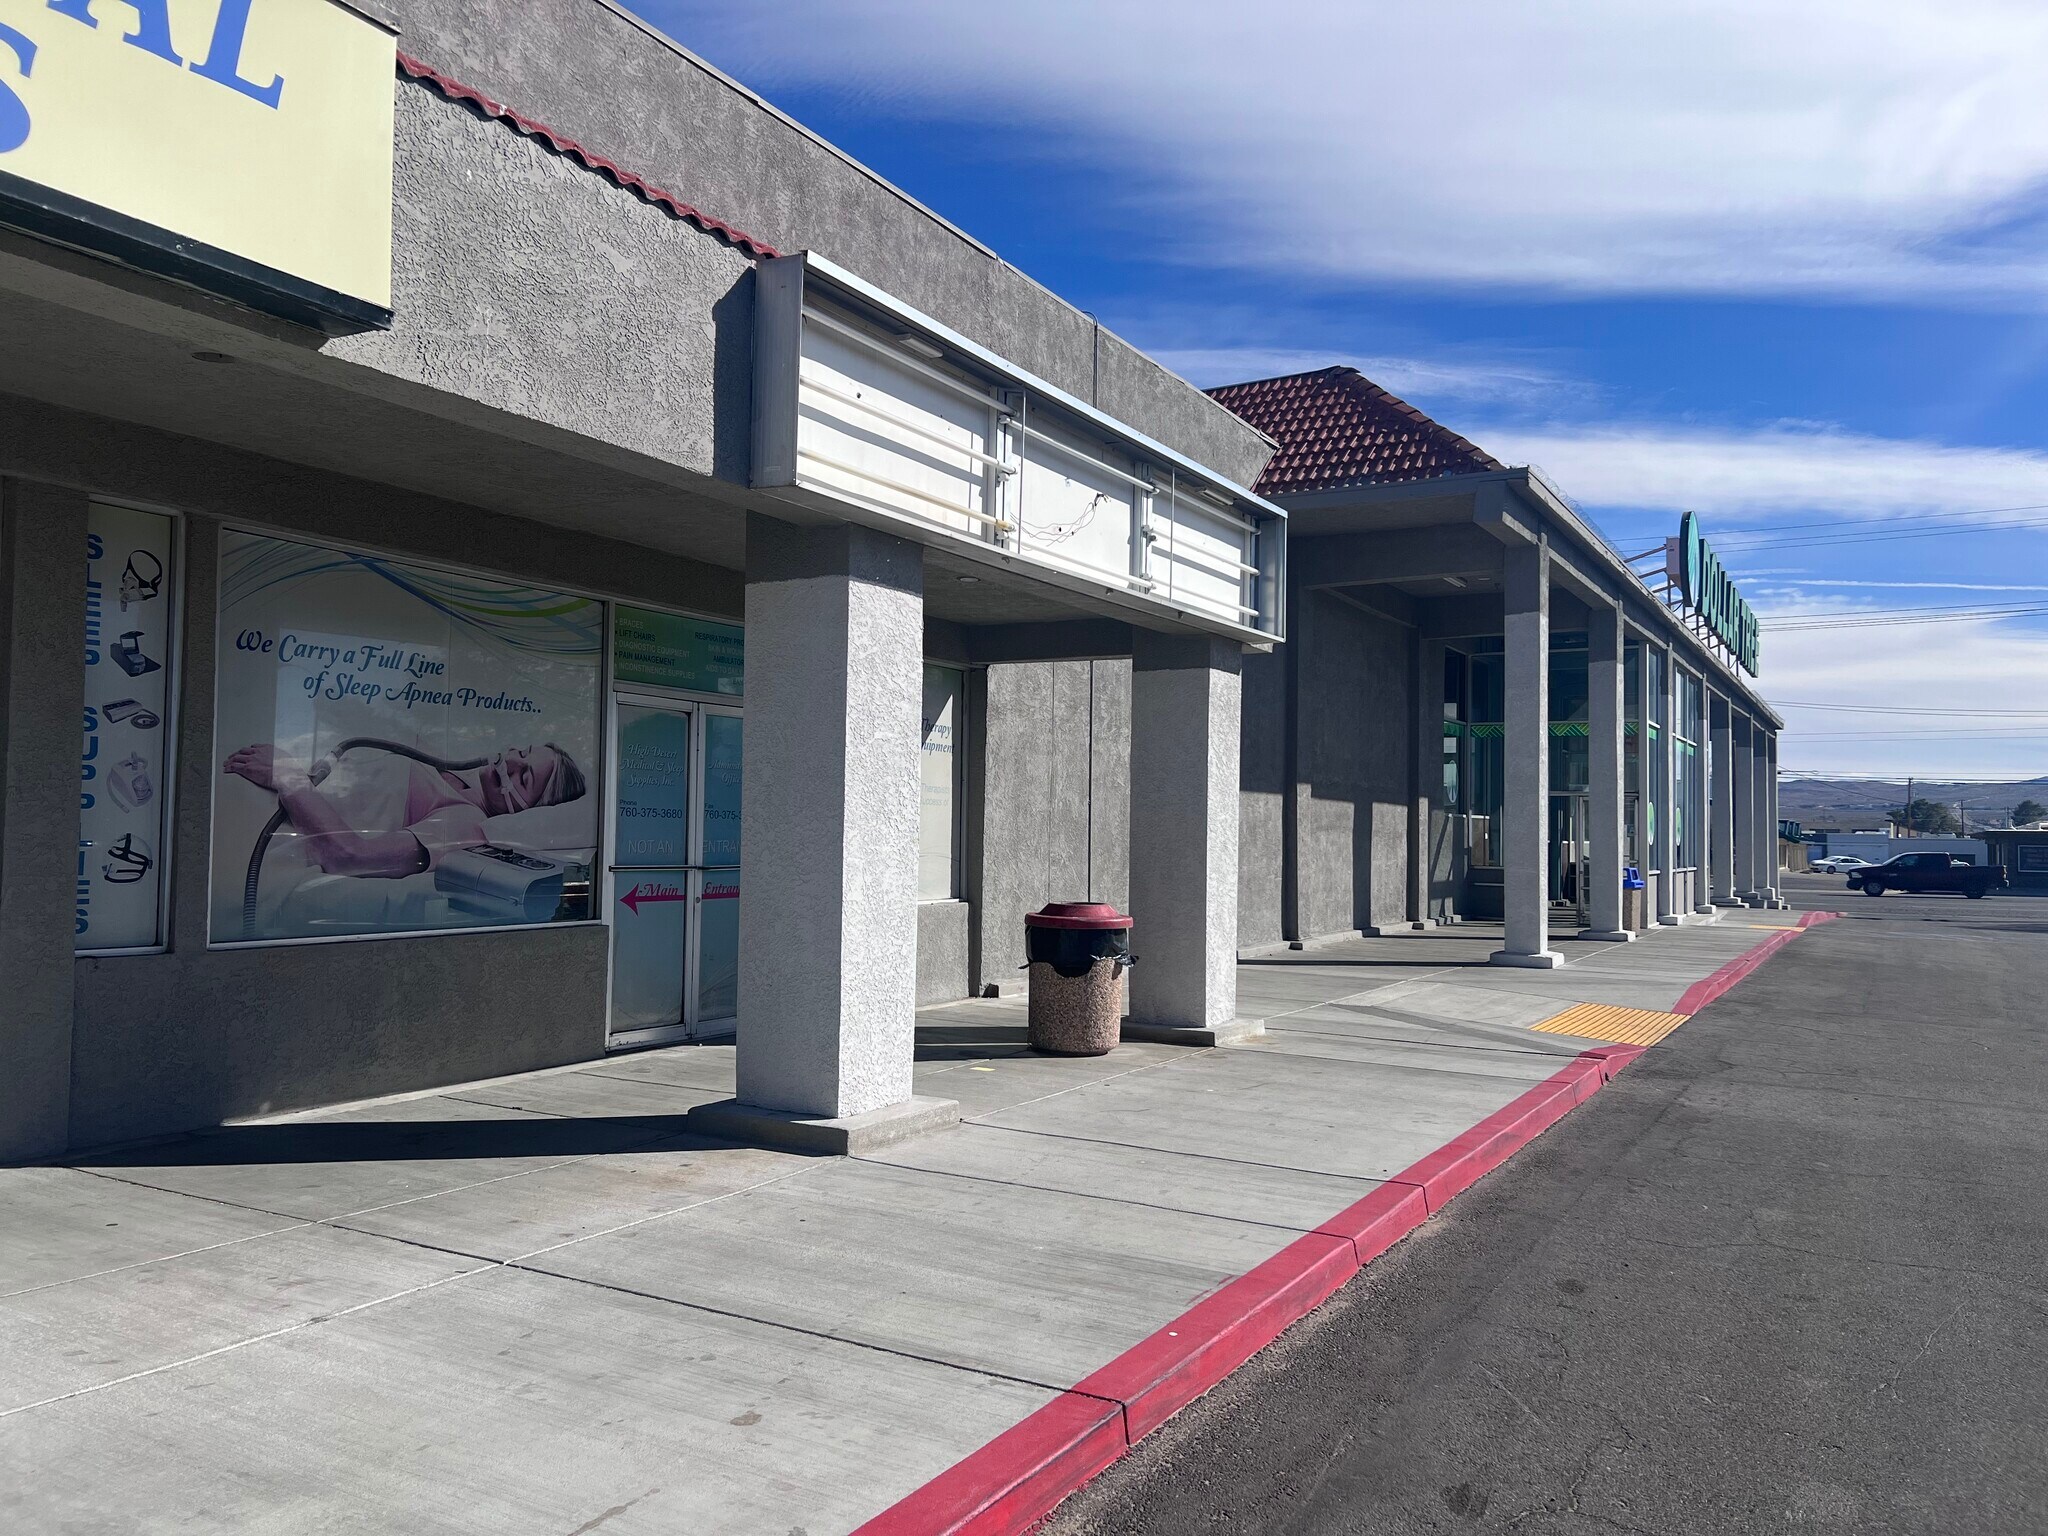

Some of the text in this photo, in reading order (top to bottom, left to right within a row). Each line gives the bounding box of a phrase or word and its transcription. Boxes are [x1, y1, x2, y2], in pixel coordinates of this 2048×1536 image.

[619, 617, 644, 629] BRACES
[619, 629, 657, 642] LIFT CHAIRS
[694, 631, 733, 644] RESPIRATORY
[236, 628, 445, 678] We Carry a Full Line
[618, 639, 690, 658] DIAGNOSTIC EQUIPMENT
[618, 650, 676, 666] PAIN MANAGEMENT
[668, 668, 696, 680] SUPPLIES
[303, 670, 543, 714] of Sleep Apnea Products..
[628, 743, 678, 759] High Desert
[620, 759, 685, 776] Medical & Sleep
[619, 806, 683, 819] 760-375-3680
[628, 839, 675, 854] NOT AN
[639, 883, 679, 896] Main
